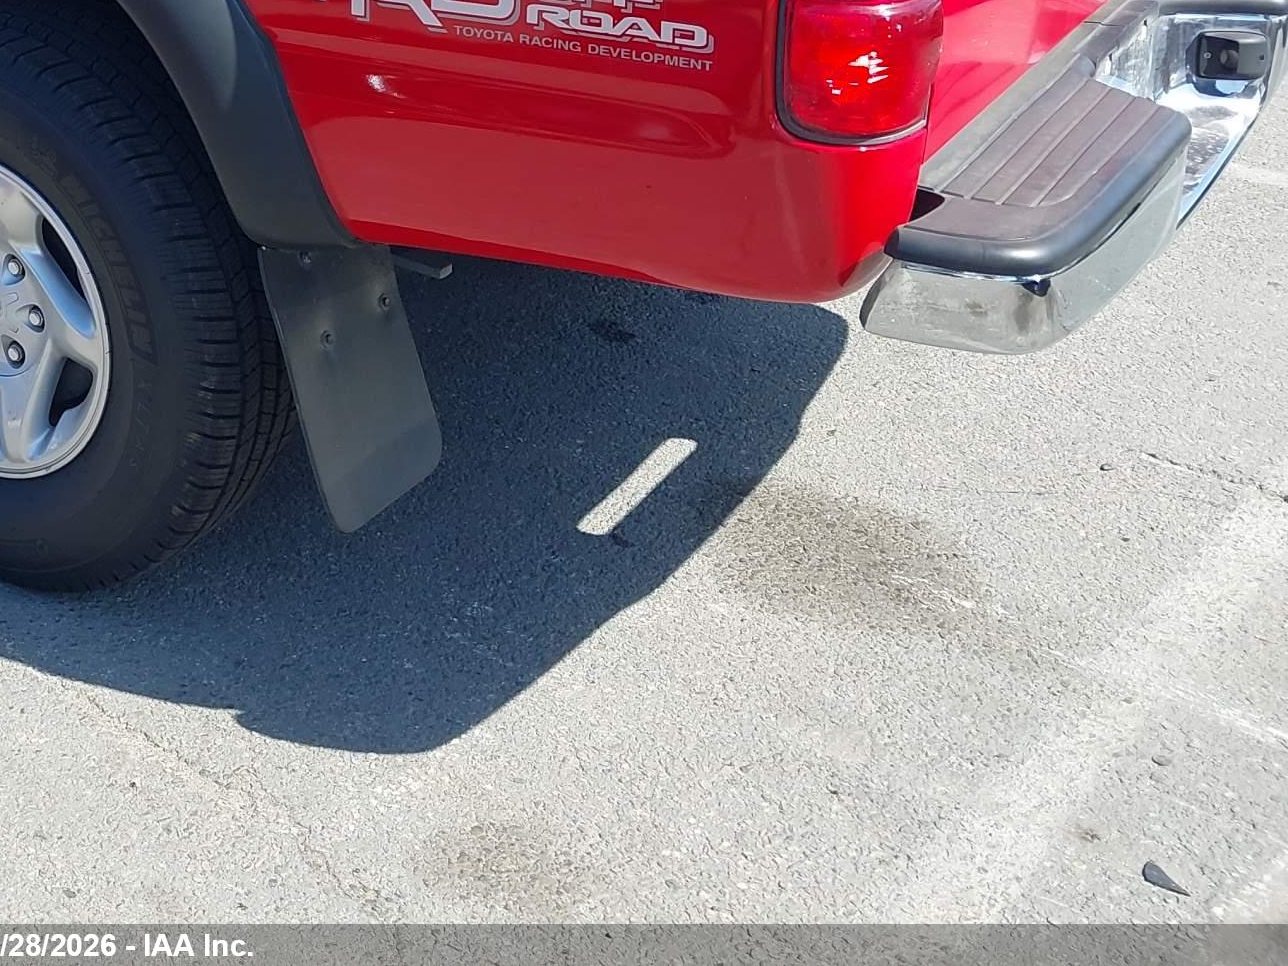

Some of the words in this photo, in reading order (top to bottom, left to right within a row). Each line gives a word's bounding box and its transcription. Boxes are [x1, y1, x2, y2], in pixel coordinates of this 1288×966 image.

[454, 25, 514, 43] TOYOTA
[519, 35, 582, 53] RACING
[588, 43, 713, 71] DEVELOPMENT
[526, 4, 714, 54] ROAD
